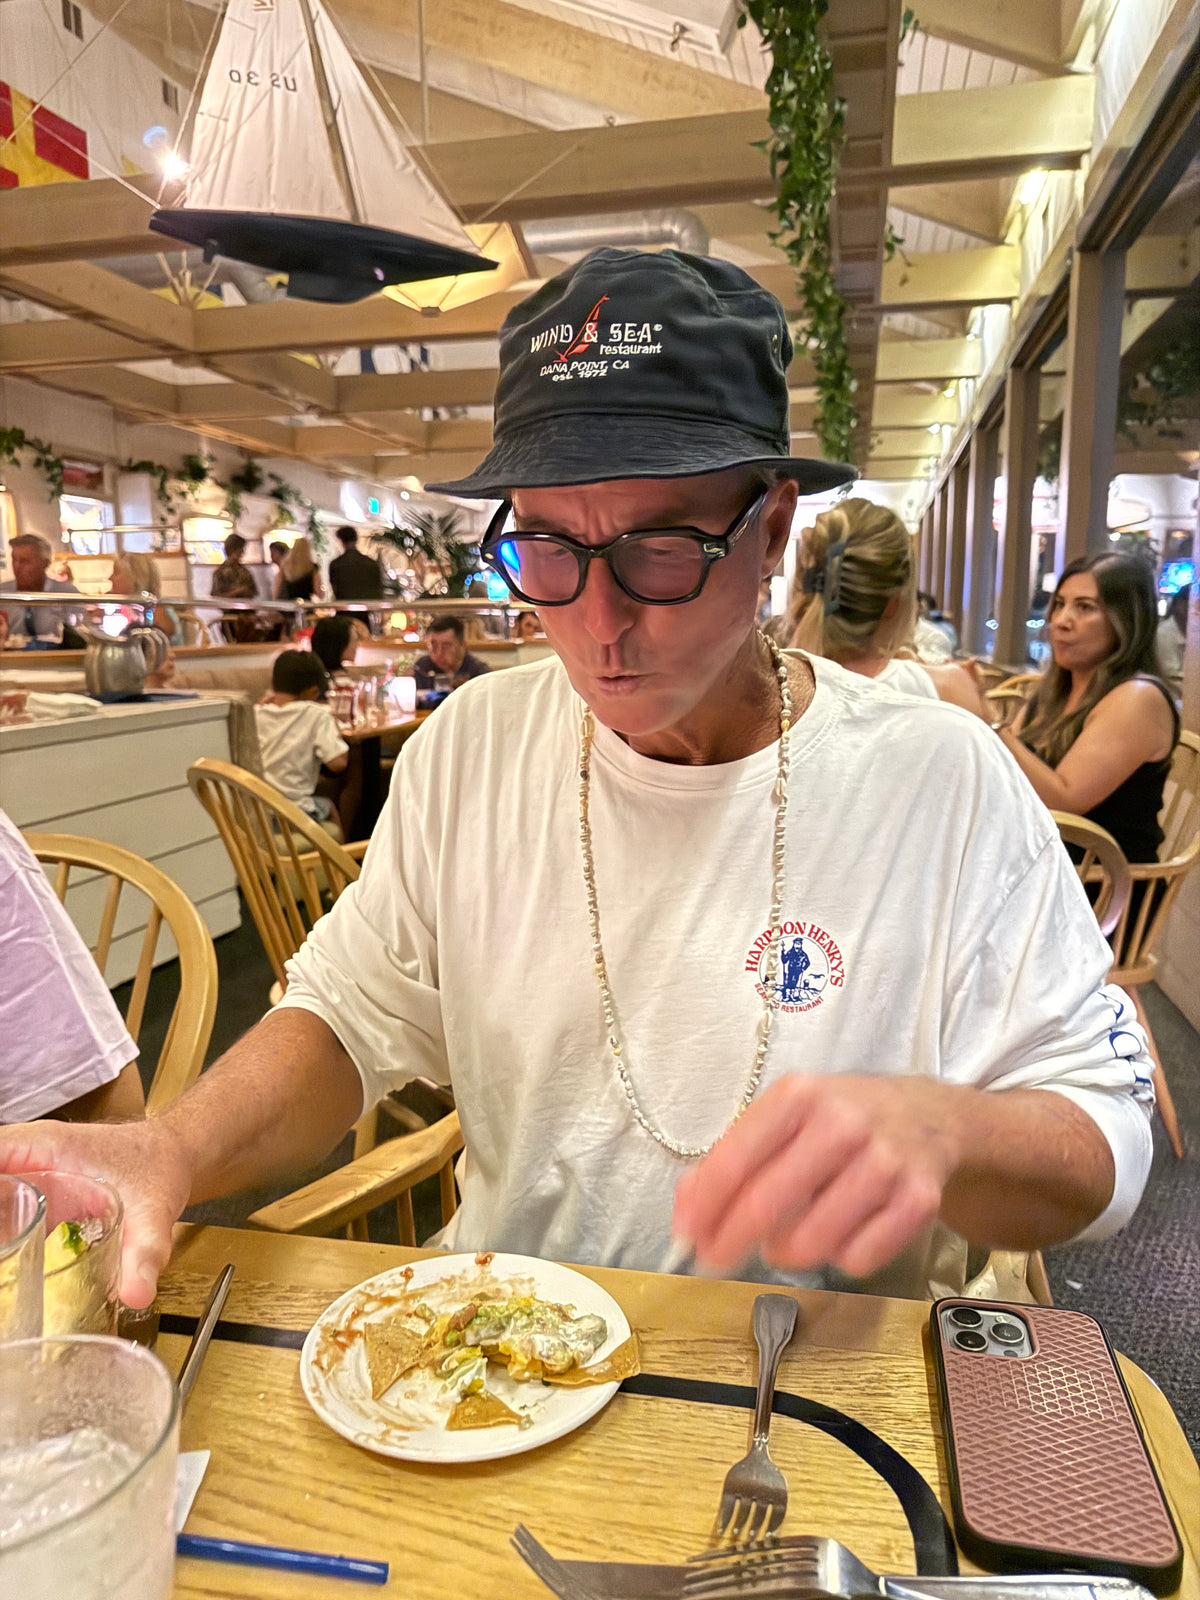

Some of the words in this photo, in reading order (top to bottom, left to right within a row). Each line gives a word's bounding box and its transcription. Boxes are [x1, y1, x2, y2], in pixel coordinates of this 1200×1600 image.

[530, 323, 573, 353] WIND
[584, 322, 598, 343] &
[600, 342, 662, 354] restaurant
[540, 363, 567, 376] DANA
[612, 360, 630, 369] CA
[578, 369, 607, 378] 1972
[781, 995, 824, 1013] RESTAURANT
